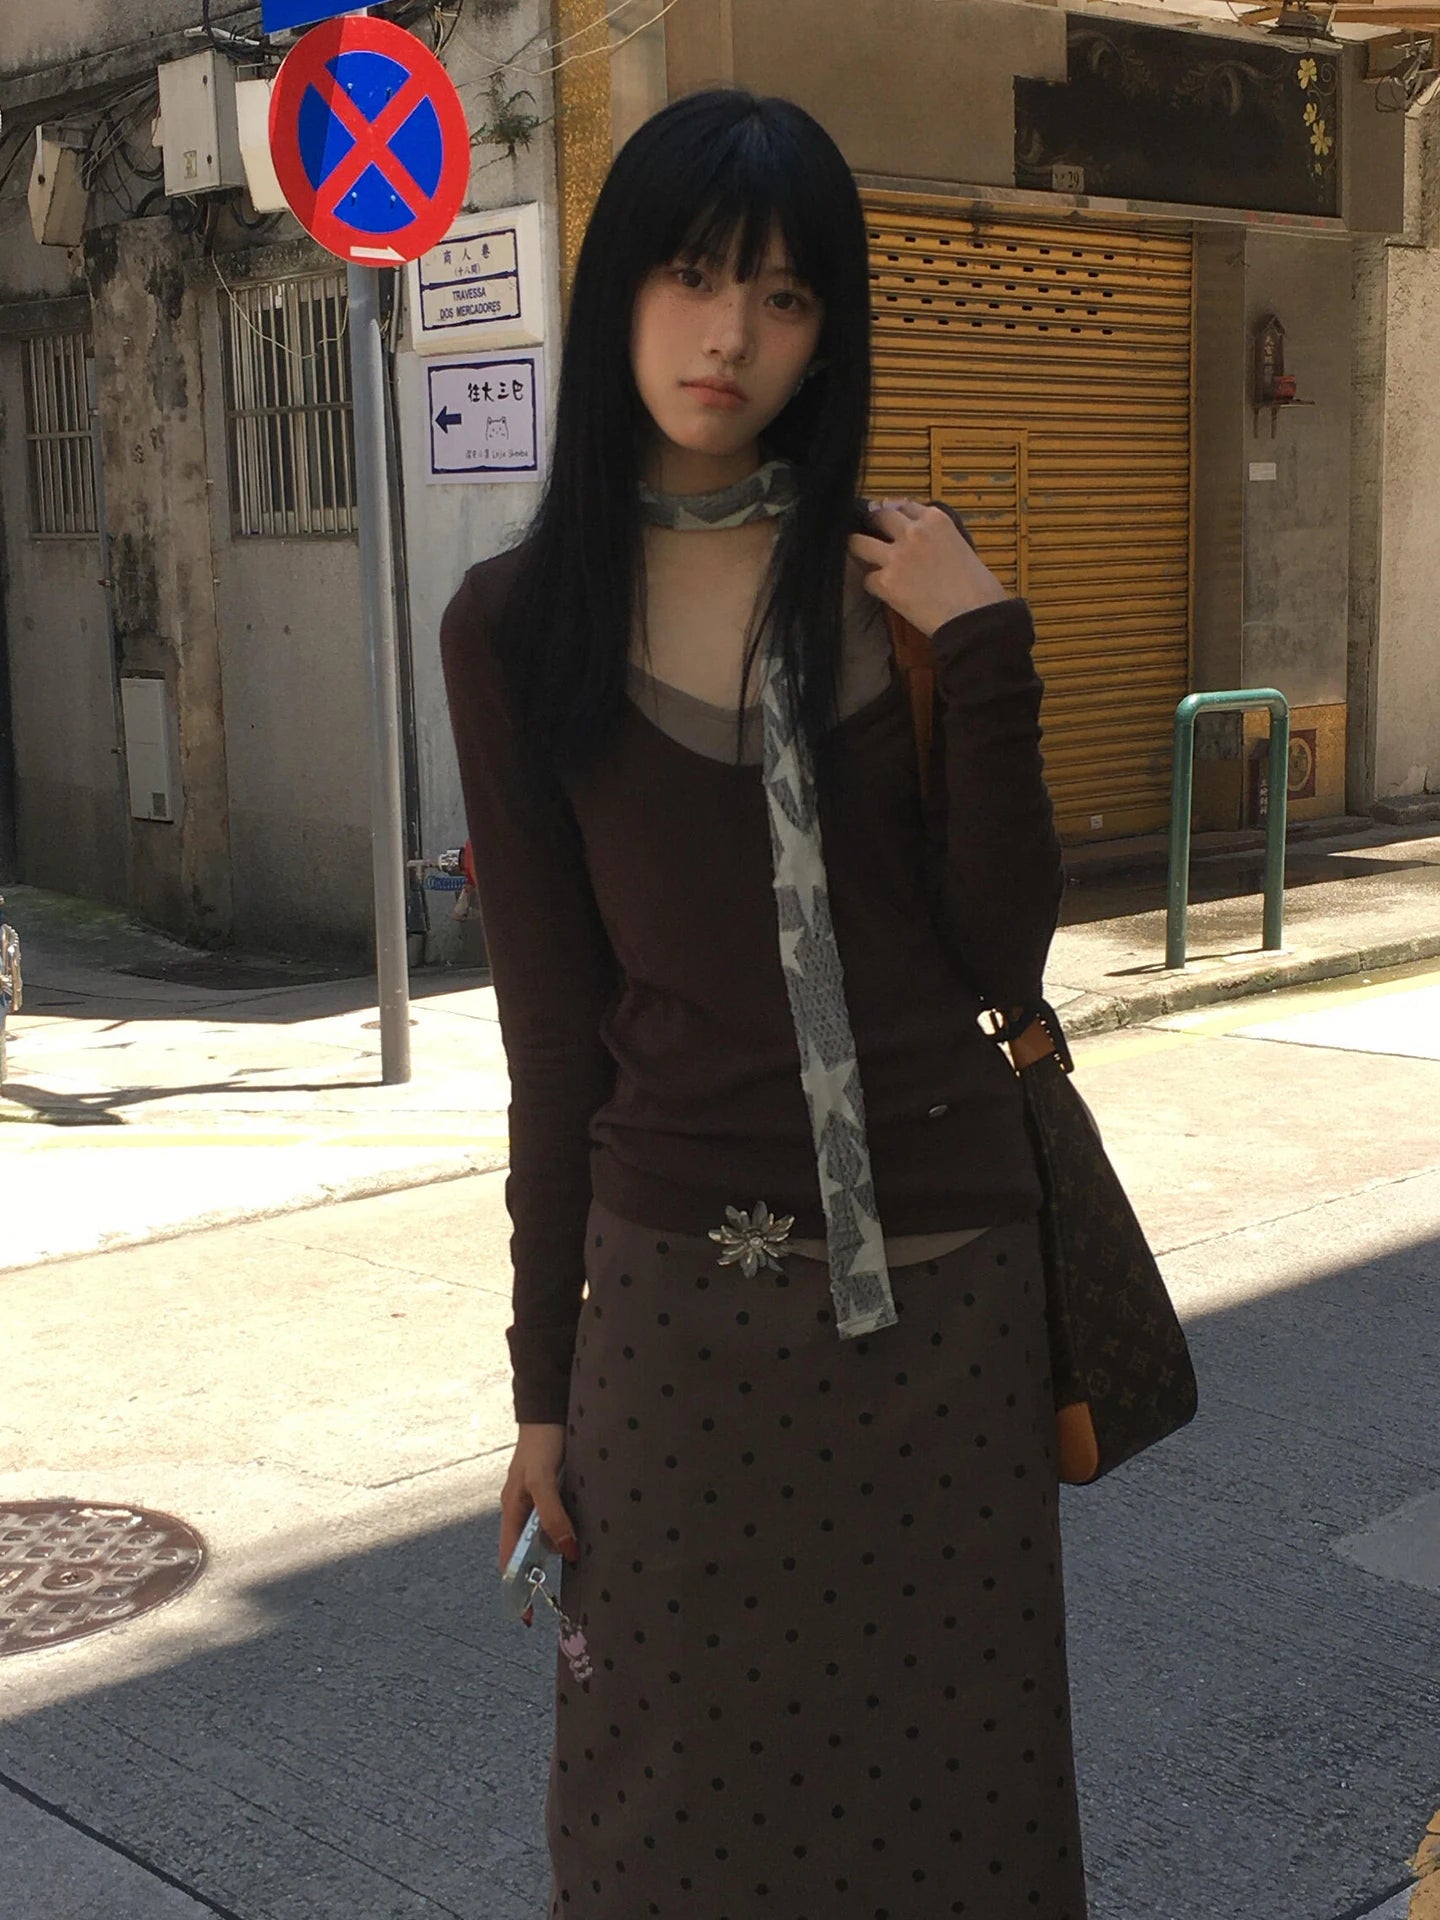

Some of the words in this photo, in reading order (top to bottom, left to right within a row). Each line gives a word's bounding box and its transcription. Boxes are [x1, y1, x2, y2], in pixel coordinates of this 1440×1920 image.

[452, 287, 486, 301] TRAVESSA
[440, 308, 454, 320] DOS
[456, 301, 501, 317] MERCADORES
[468, 380, 523, 402] 往大三巴
